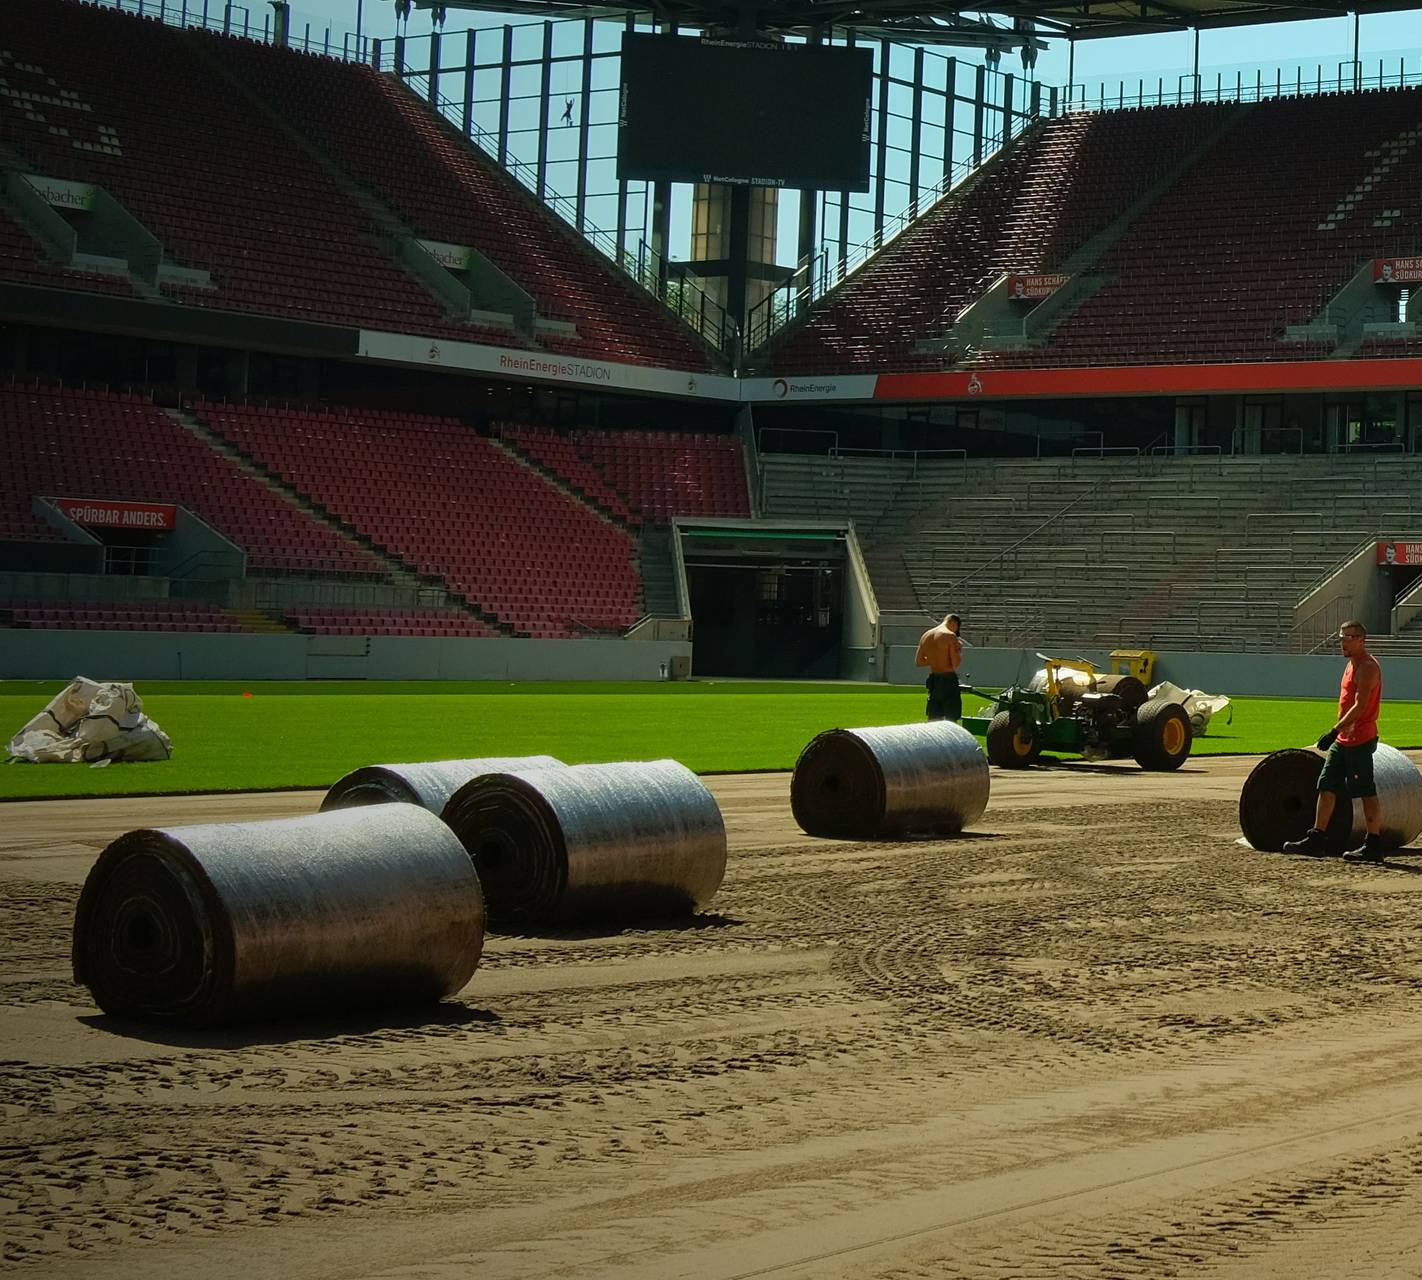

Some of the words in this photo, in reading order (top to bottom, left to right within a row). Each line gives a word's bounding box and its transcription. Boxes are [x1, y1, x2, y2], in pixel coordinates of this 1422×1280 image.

[1395, 259, 1414, 270] HANS
[1026, 277, 1043, 287] HANS
[499, 354, 611, 381] RheinEnergieSTADION
[790, 383, 837, 394] RheinEnergie
[69, 505, 119, 524] SPÜRBAR
[122, 510, 167, 527] ANDERS.
